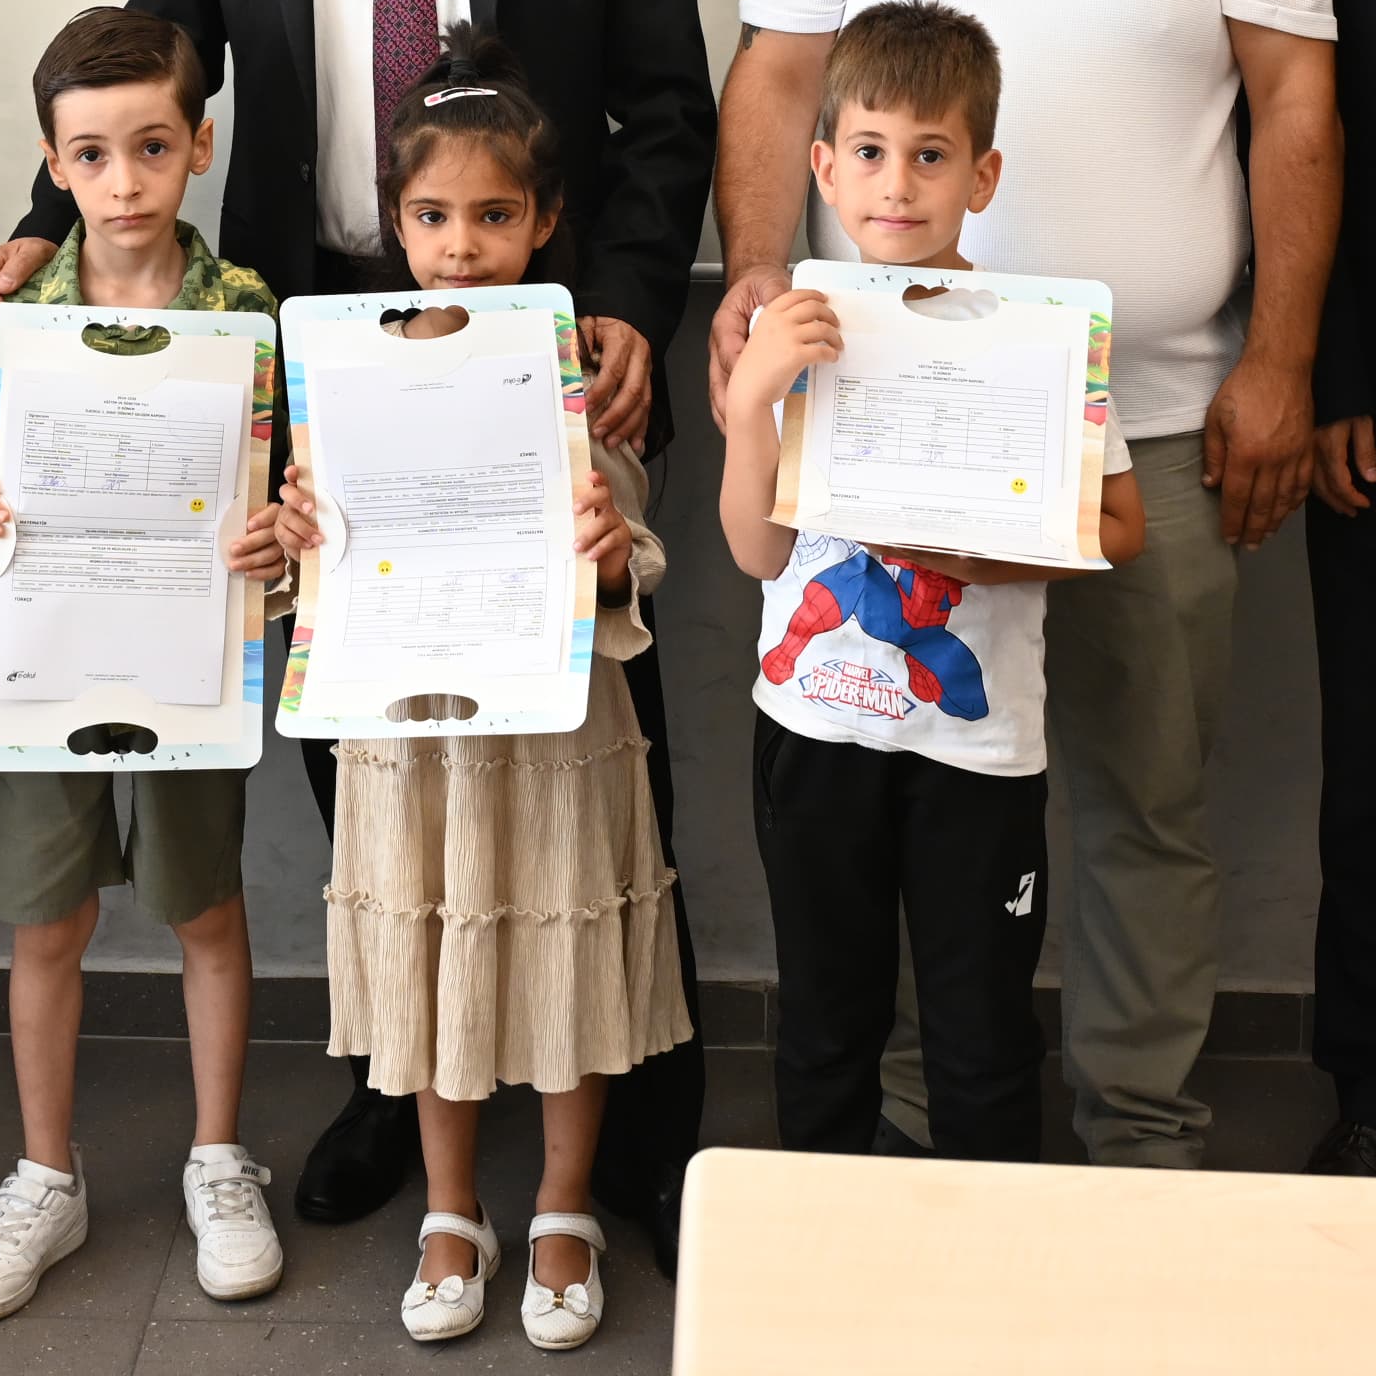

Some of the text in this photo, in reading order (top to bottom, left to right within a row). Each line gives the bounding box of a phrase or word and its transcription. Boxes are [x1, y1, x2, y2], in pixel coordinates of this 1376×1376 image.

[844, 663, 870, 680] MARVEL
[803, 672, 906, 720] SPIDER-MAN
[240, 1163, 262, 1179] NIKE
